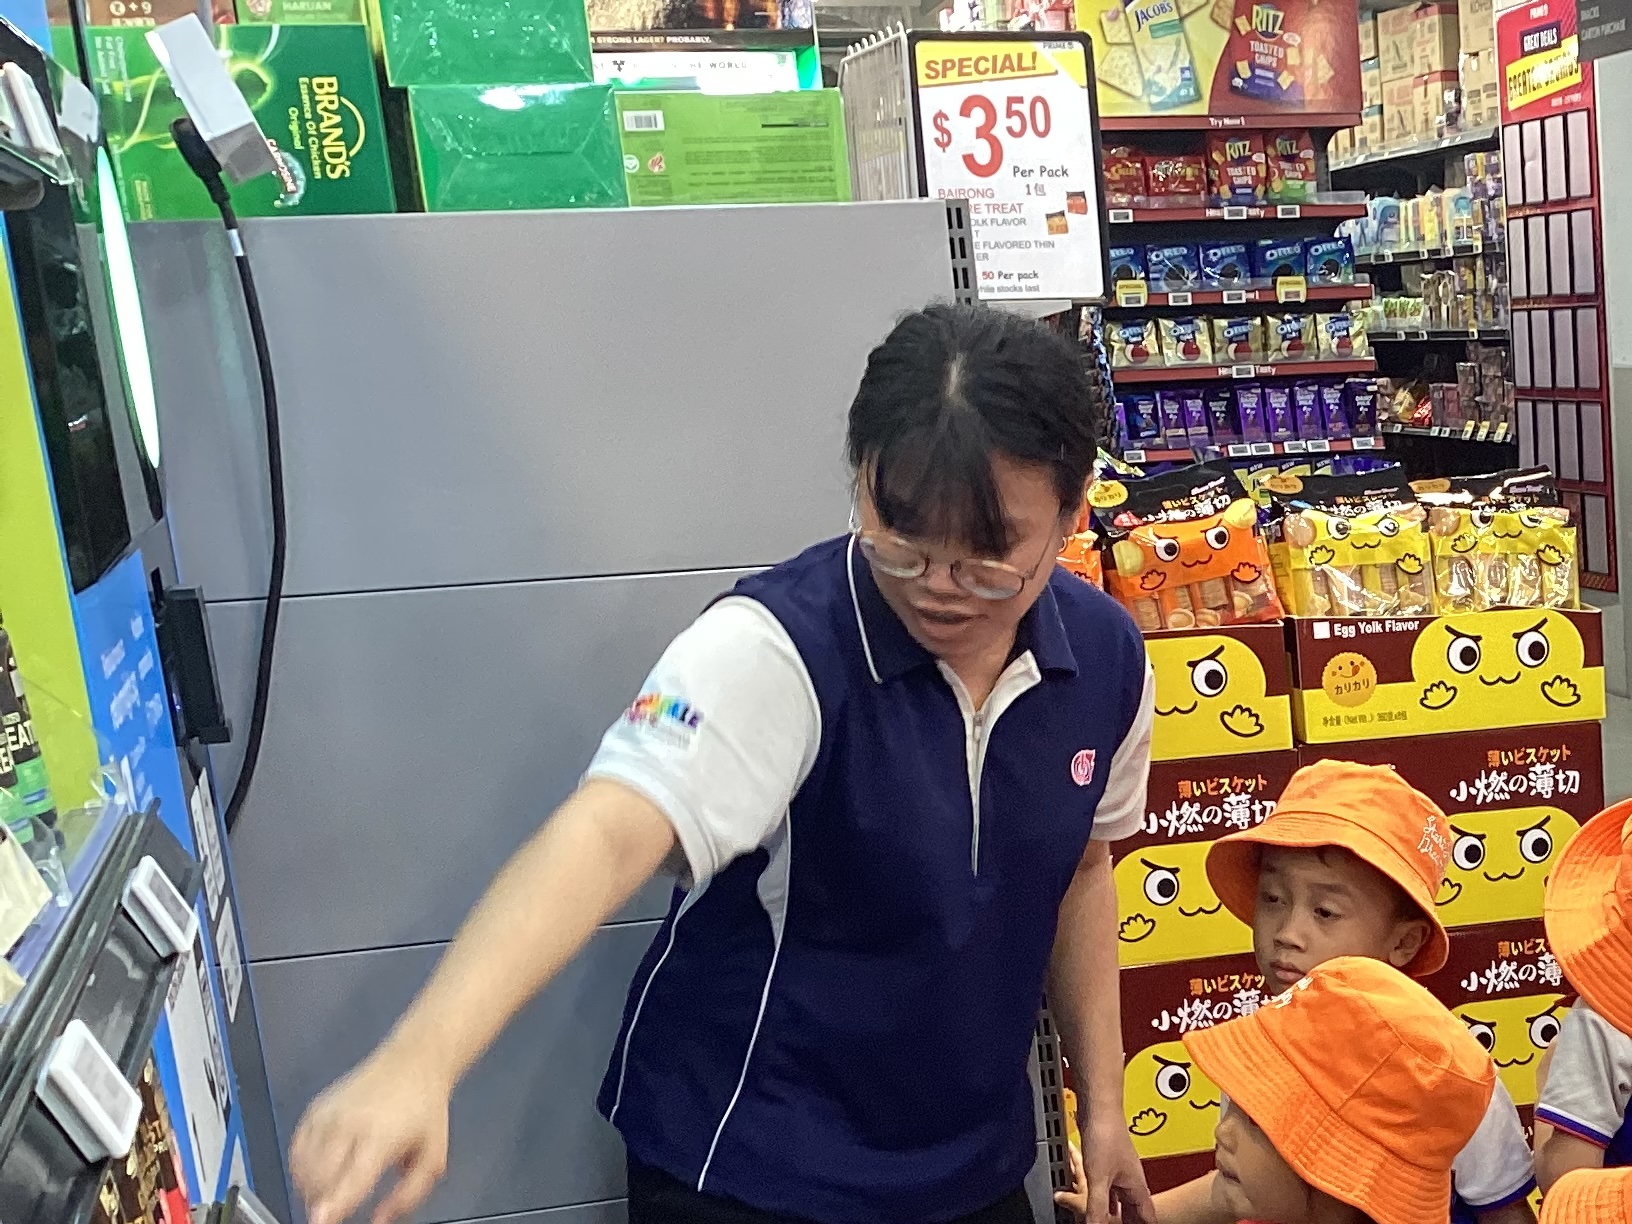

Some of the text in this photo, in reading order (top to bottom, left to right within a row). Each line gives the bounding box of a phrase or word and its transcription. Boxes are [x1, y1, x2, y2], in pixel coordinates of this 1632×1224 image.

[1252, 5, 1285, 35] RITZ
[1250, 40, 1284, 58] TOASTED
[925, 51, 1038, 80] SPECIAL!
[288, 107, 304, 149] Original
[312, 76, 351, 179] BRAND'S
[1209, 117, 1222, 128] Try
[1225, 140, 1252, 161] RITZ
[1275, 138, 1299, 156] RITZ
[308, 137, 321, 179] Chicken
[1013, 165, 1069, 178] Per Pack
[938, 188, 995, 199] BAIRONG
[985, 203, 1024, 214] TREAT
[990, 217, 1027, 226] FLAVOR
[983, 240, 1032, 249] FLAVORED
[1034, 240, 1055, 248] THIN
[1209, 244, 1245, 260] OREO
[1265, 244, 1300, 260] OREO
[1310, 241, 1345, 255] OREO
[1151, 247, 1187, 261] OREO
[998, 271, 1014, 280] Per
[1017, 270, 1039, 282] pack
[1224, 324, 1253, 338] OREO
[1333, 619, 1420, 639] Egg Yolk Flavor
[1334, 678, 1370, 696] カリカリ
[1487, 744, 1571, 768] 薄いビスケット
[1178, 773, 1268, 798] 薄いビスケット
[1449, 762, 1580, 805] 小燃の薄切
[1140, 792, 1277, 837] 小燃の薄切
